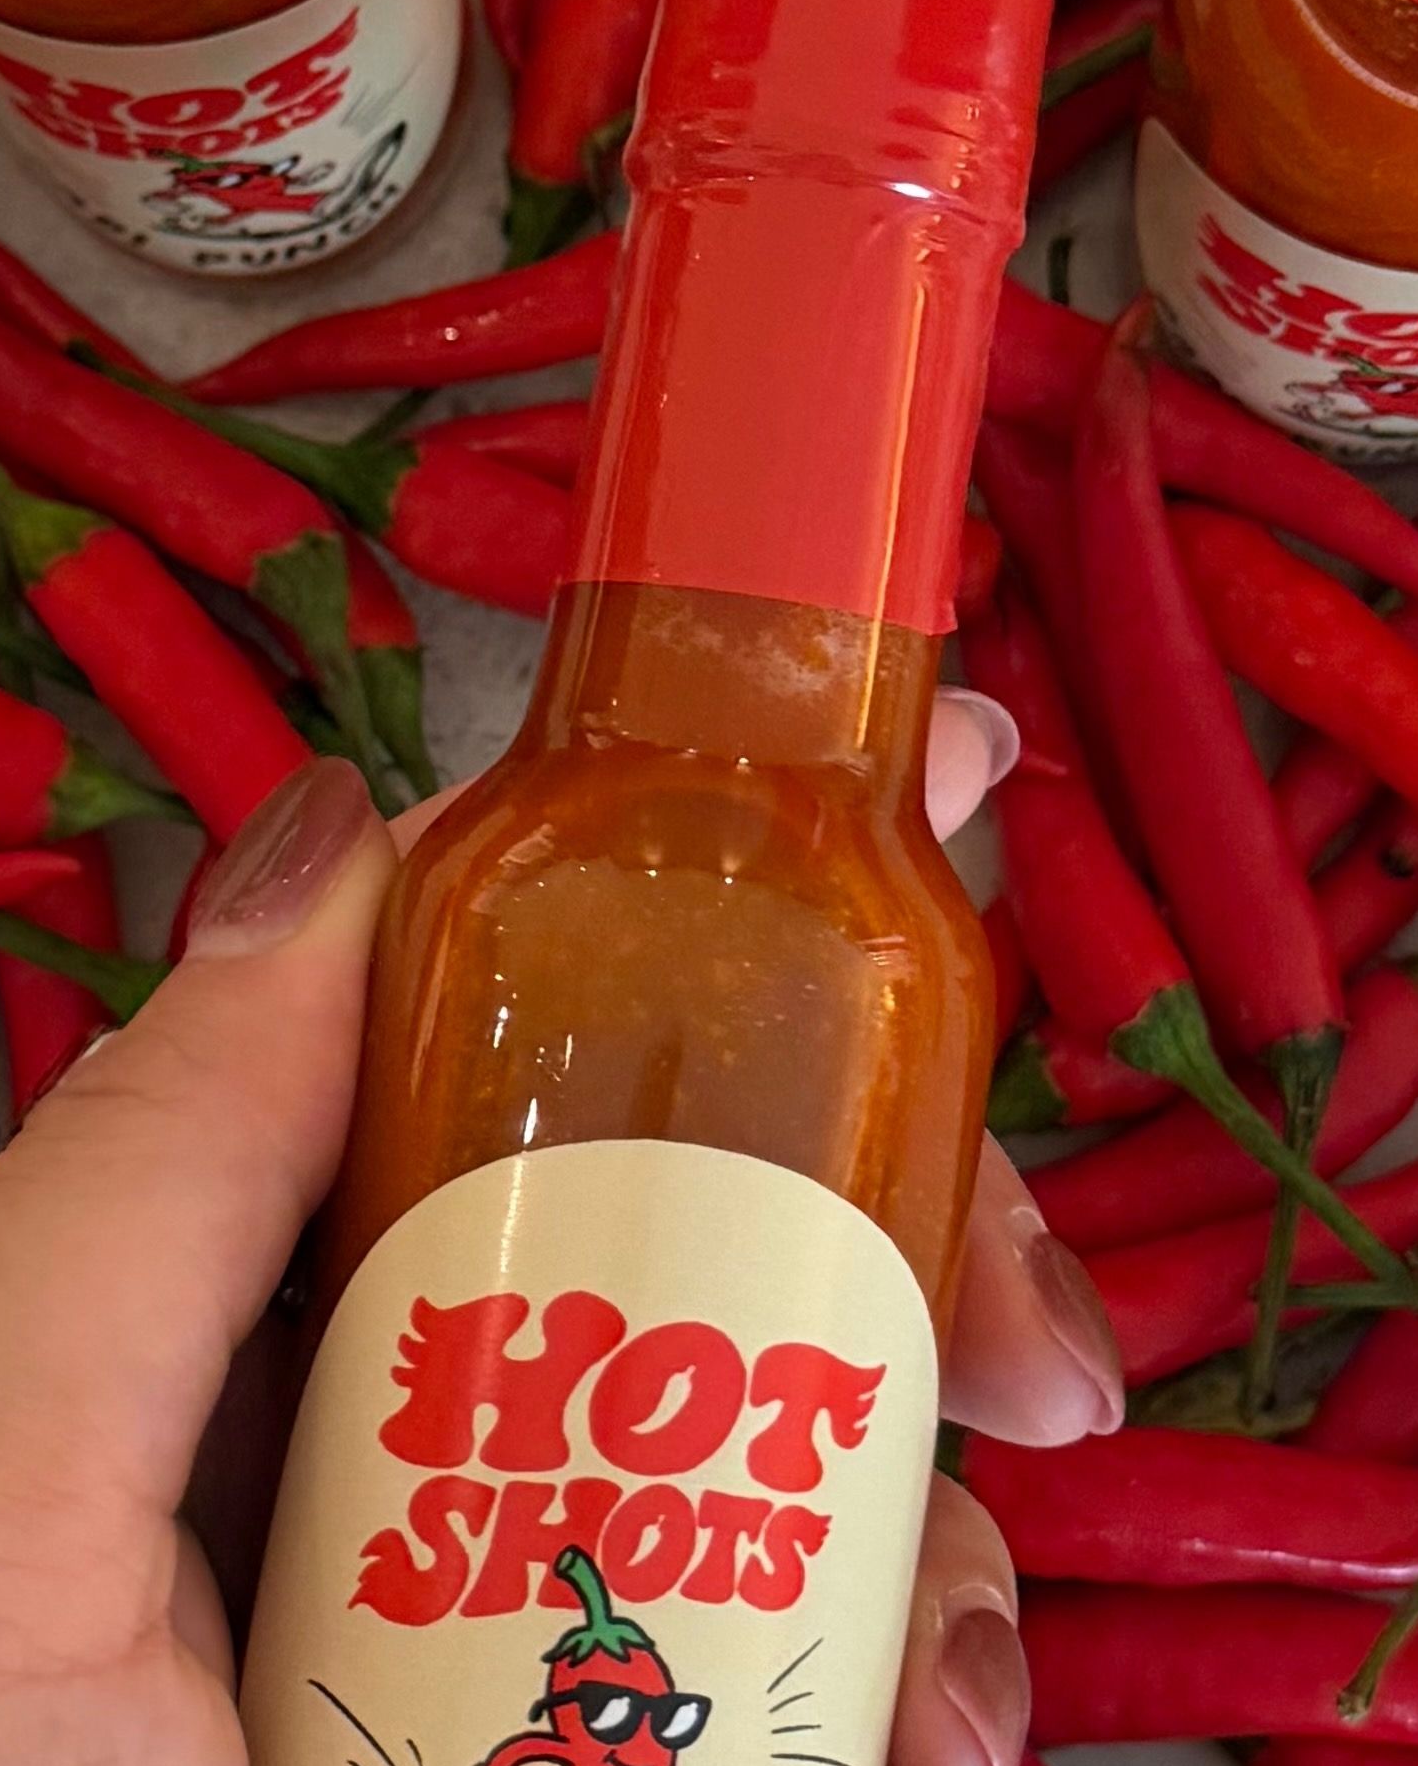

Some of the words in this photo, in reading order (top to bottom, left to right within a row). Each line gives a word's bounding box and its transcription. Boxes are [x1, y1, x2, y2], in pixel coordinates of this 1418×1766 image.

[13, 67, 351, 160] SHOTS
[379, 1291, 886, 1493] HOT
[348, 1476, 832, 1627] SHOTS
